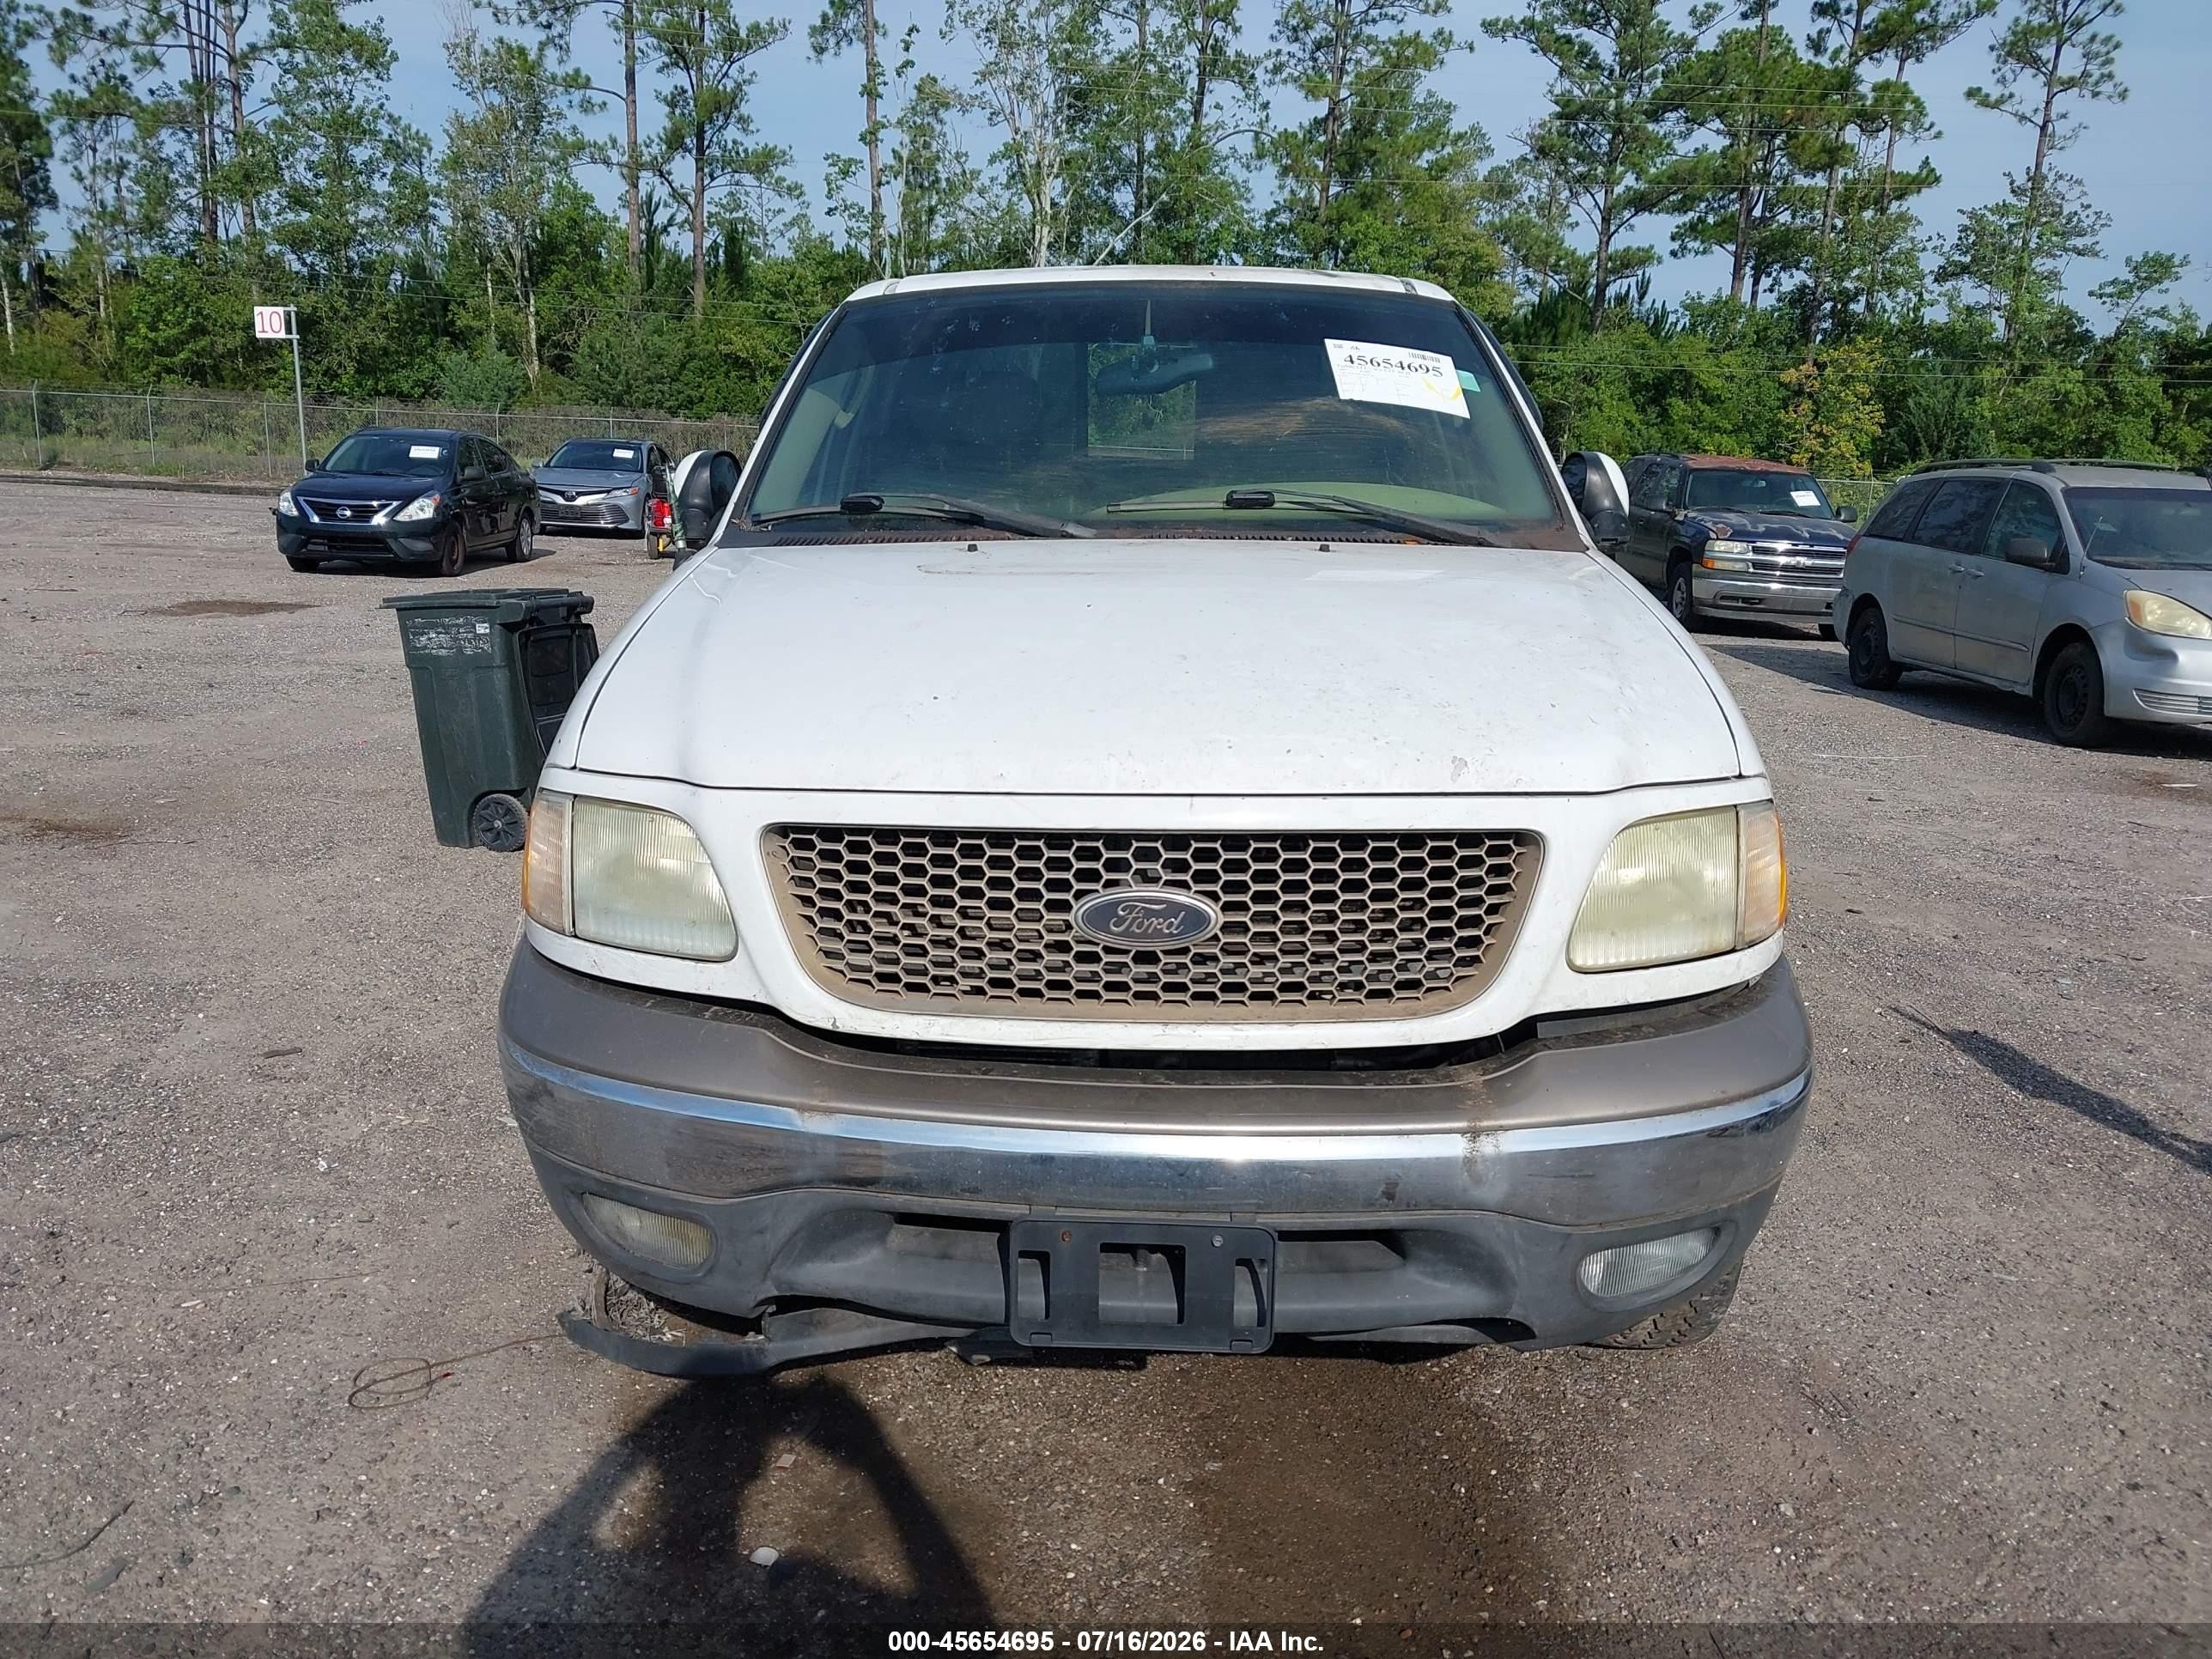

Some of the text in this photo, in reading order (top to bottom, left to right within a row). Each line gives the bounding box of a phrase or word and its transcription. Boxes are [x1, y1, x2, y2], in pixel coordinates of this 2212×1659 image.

[257, 311, 283, 334] 10
[1344, 354, 1443, 378] 45654695
[1109, 902, 1186, 934] Ford
